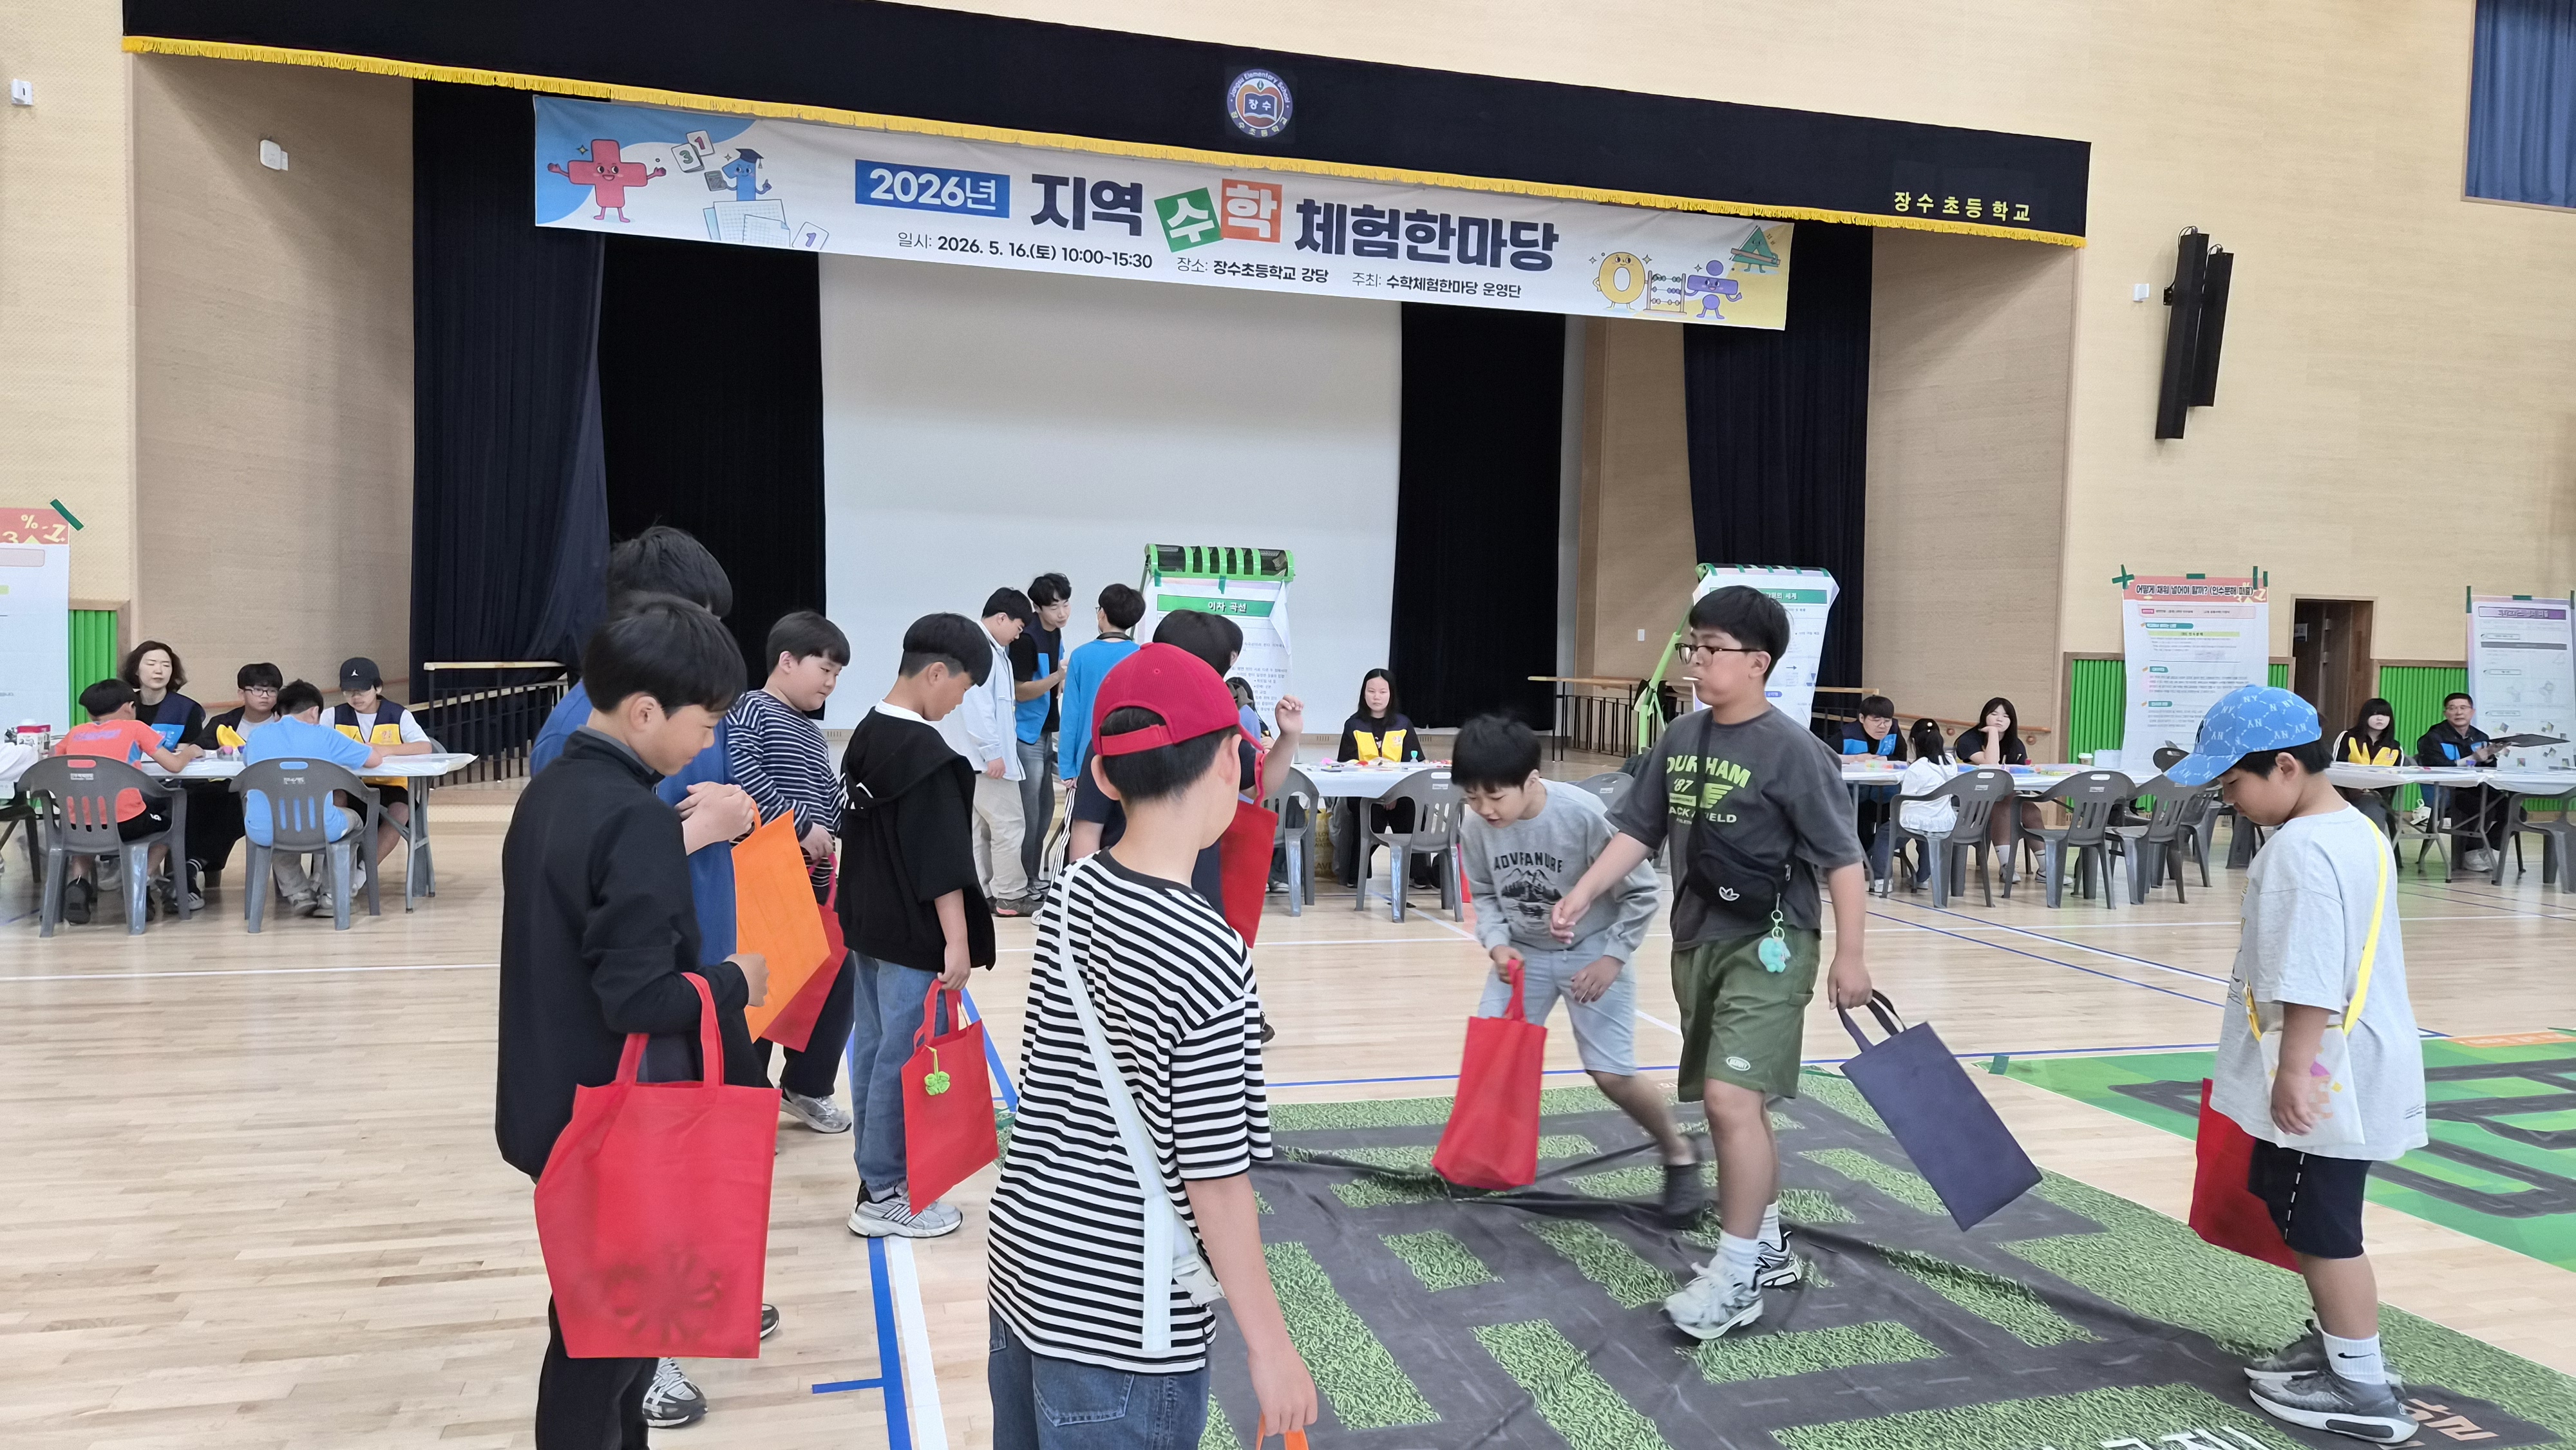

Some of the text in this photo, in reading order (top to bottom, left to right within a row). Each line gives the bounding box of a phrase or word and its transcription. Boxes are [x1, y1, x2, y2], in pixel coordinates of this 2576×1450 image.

[1244, 72, 1278, 84] Elementary
[1278, 82, 1291, 103] School
[1249, 99, 1271, 111] 장수
[869, 169, 1560, 272] 2026년 지역 수학 체험한마당
[898, 232, 1153, 268] 일시: 2026. 5. 16.(토) 10:00~15:30
[1177, 257, 1329, 283] 장소: 장수초등학교 강당
[1352, 272, 1522, 299] 주최: 수학체험한마당 운영단
[1208, 601, 1247, 613] 이차 곡선
[1667, 755, 1752, 788] DURHAM
[1669, 805, 1690, 818] ACK
[1705, 812, 1738, 823] IELD
